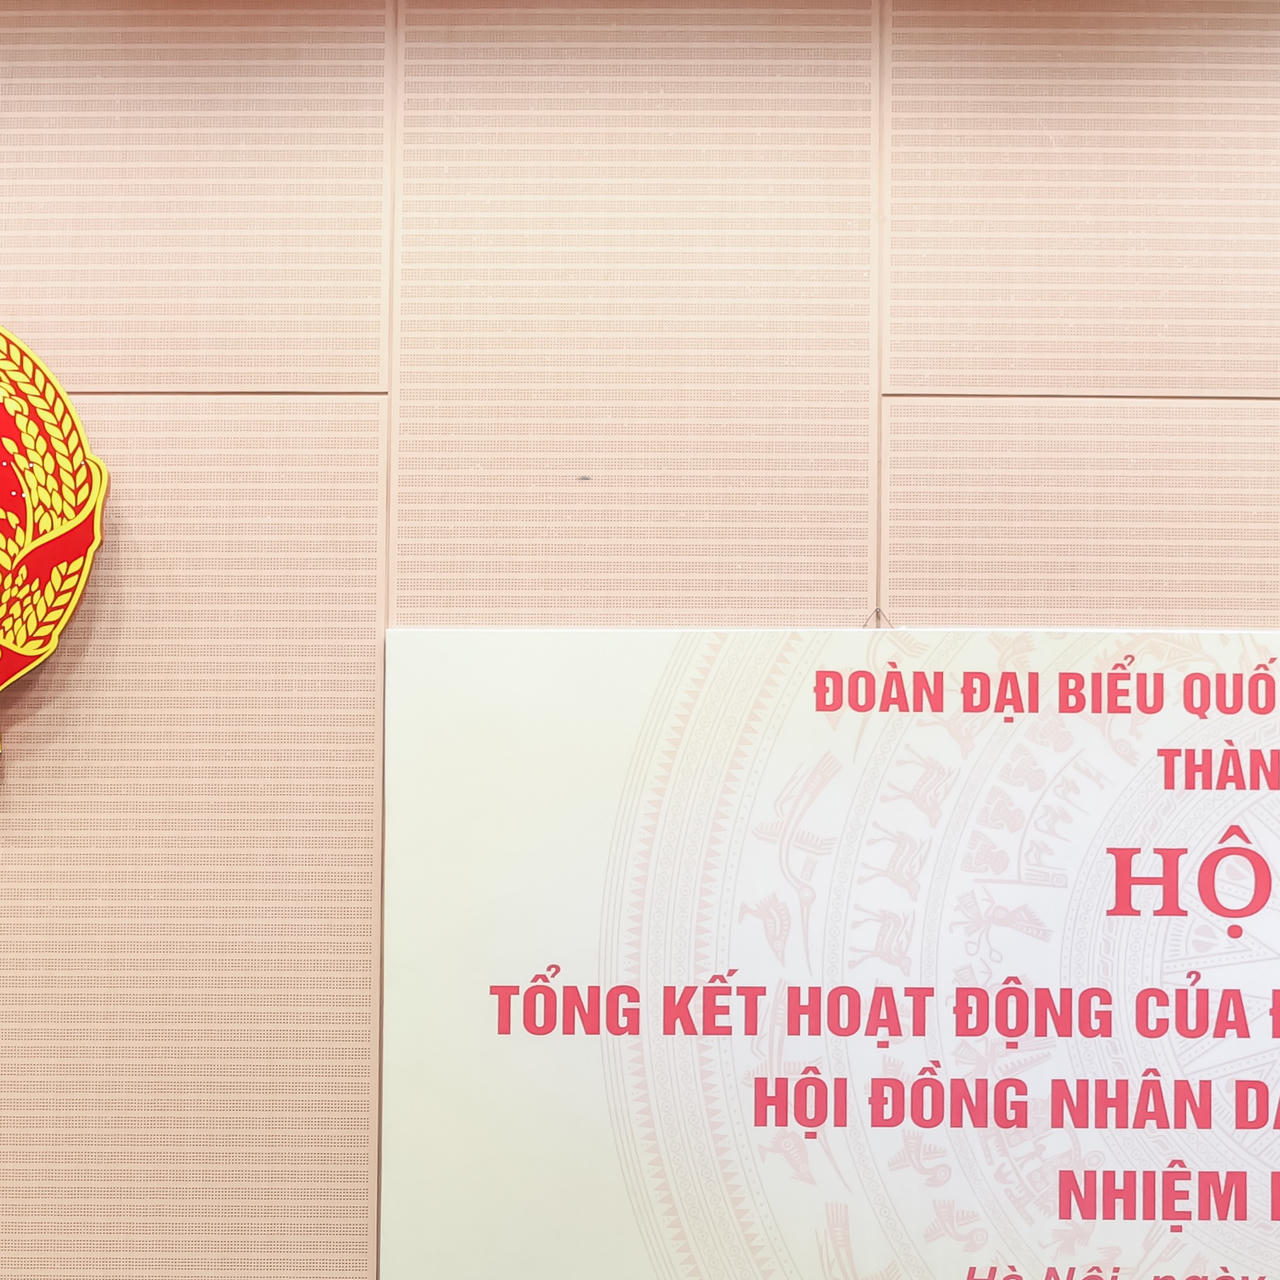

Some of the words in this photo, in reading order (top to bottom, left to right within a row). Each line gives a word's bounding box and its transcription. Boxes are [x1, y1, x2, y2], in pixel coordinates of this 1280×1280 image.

[814, 662, 944, 713] ĐOÀN
[961, 671, 1039, 723] ĐẠI
[1059, 654, 1164, 715] BIỂU
[489, 964, 640, 1036] TỔNG
[663, 968, 767, 1036] KẾT
[787, 986, 935, 1049] HOẠT
[953, 977, 1112, 1049] ĐỘNG
[1135, 970, 1250, 1039] CỦA
[754, 1066, 847, 1139] HỘI
[868, 1060, 1028, 1129] ĐỒNG
[1051, 1068, 1212, 1130] NHÂN
[1059, 1159, 1247, 1233] NHIỆM
